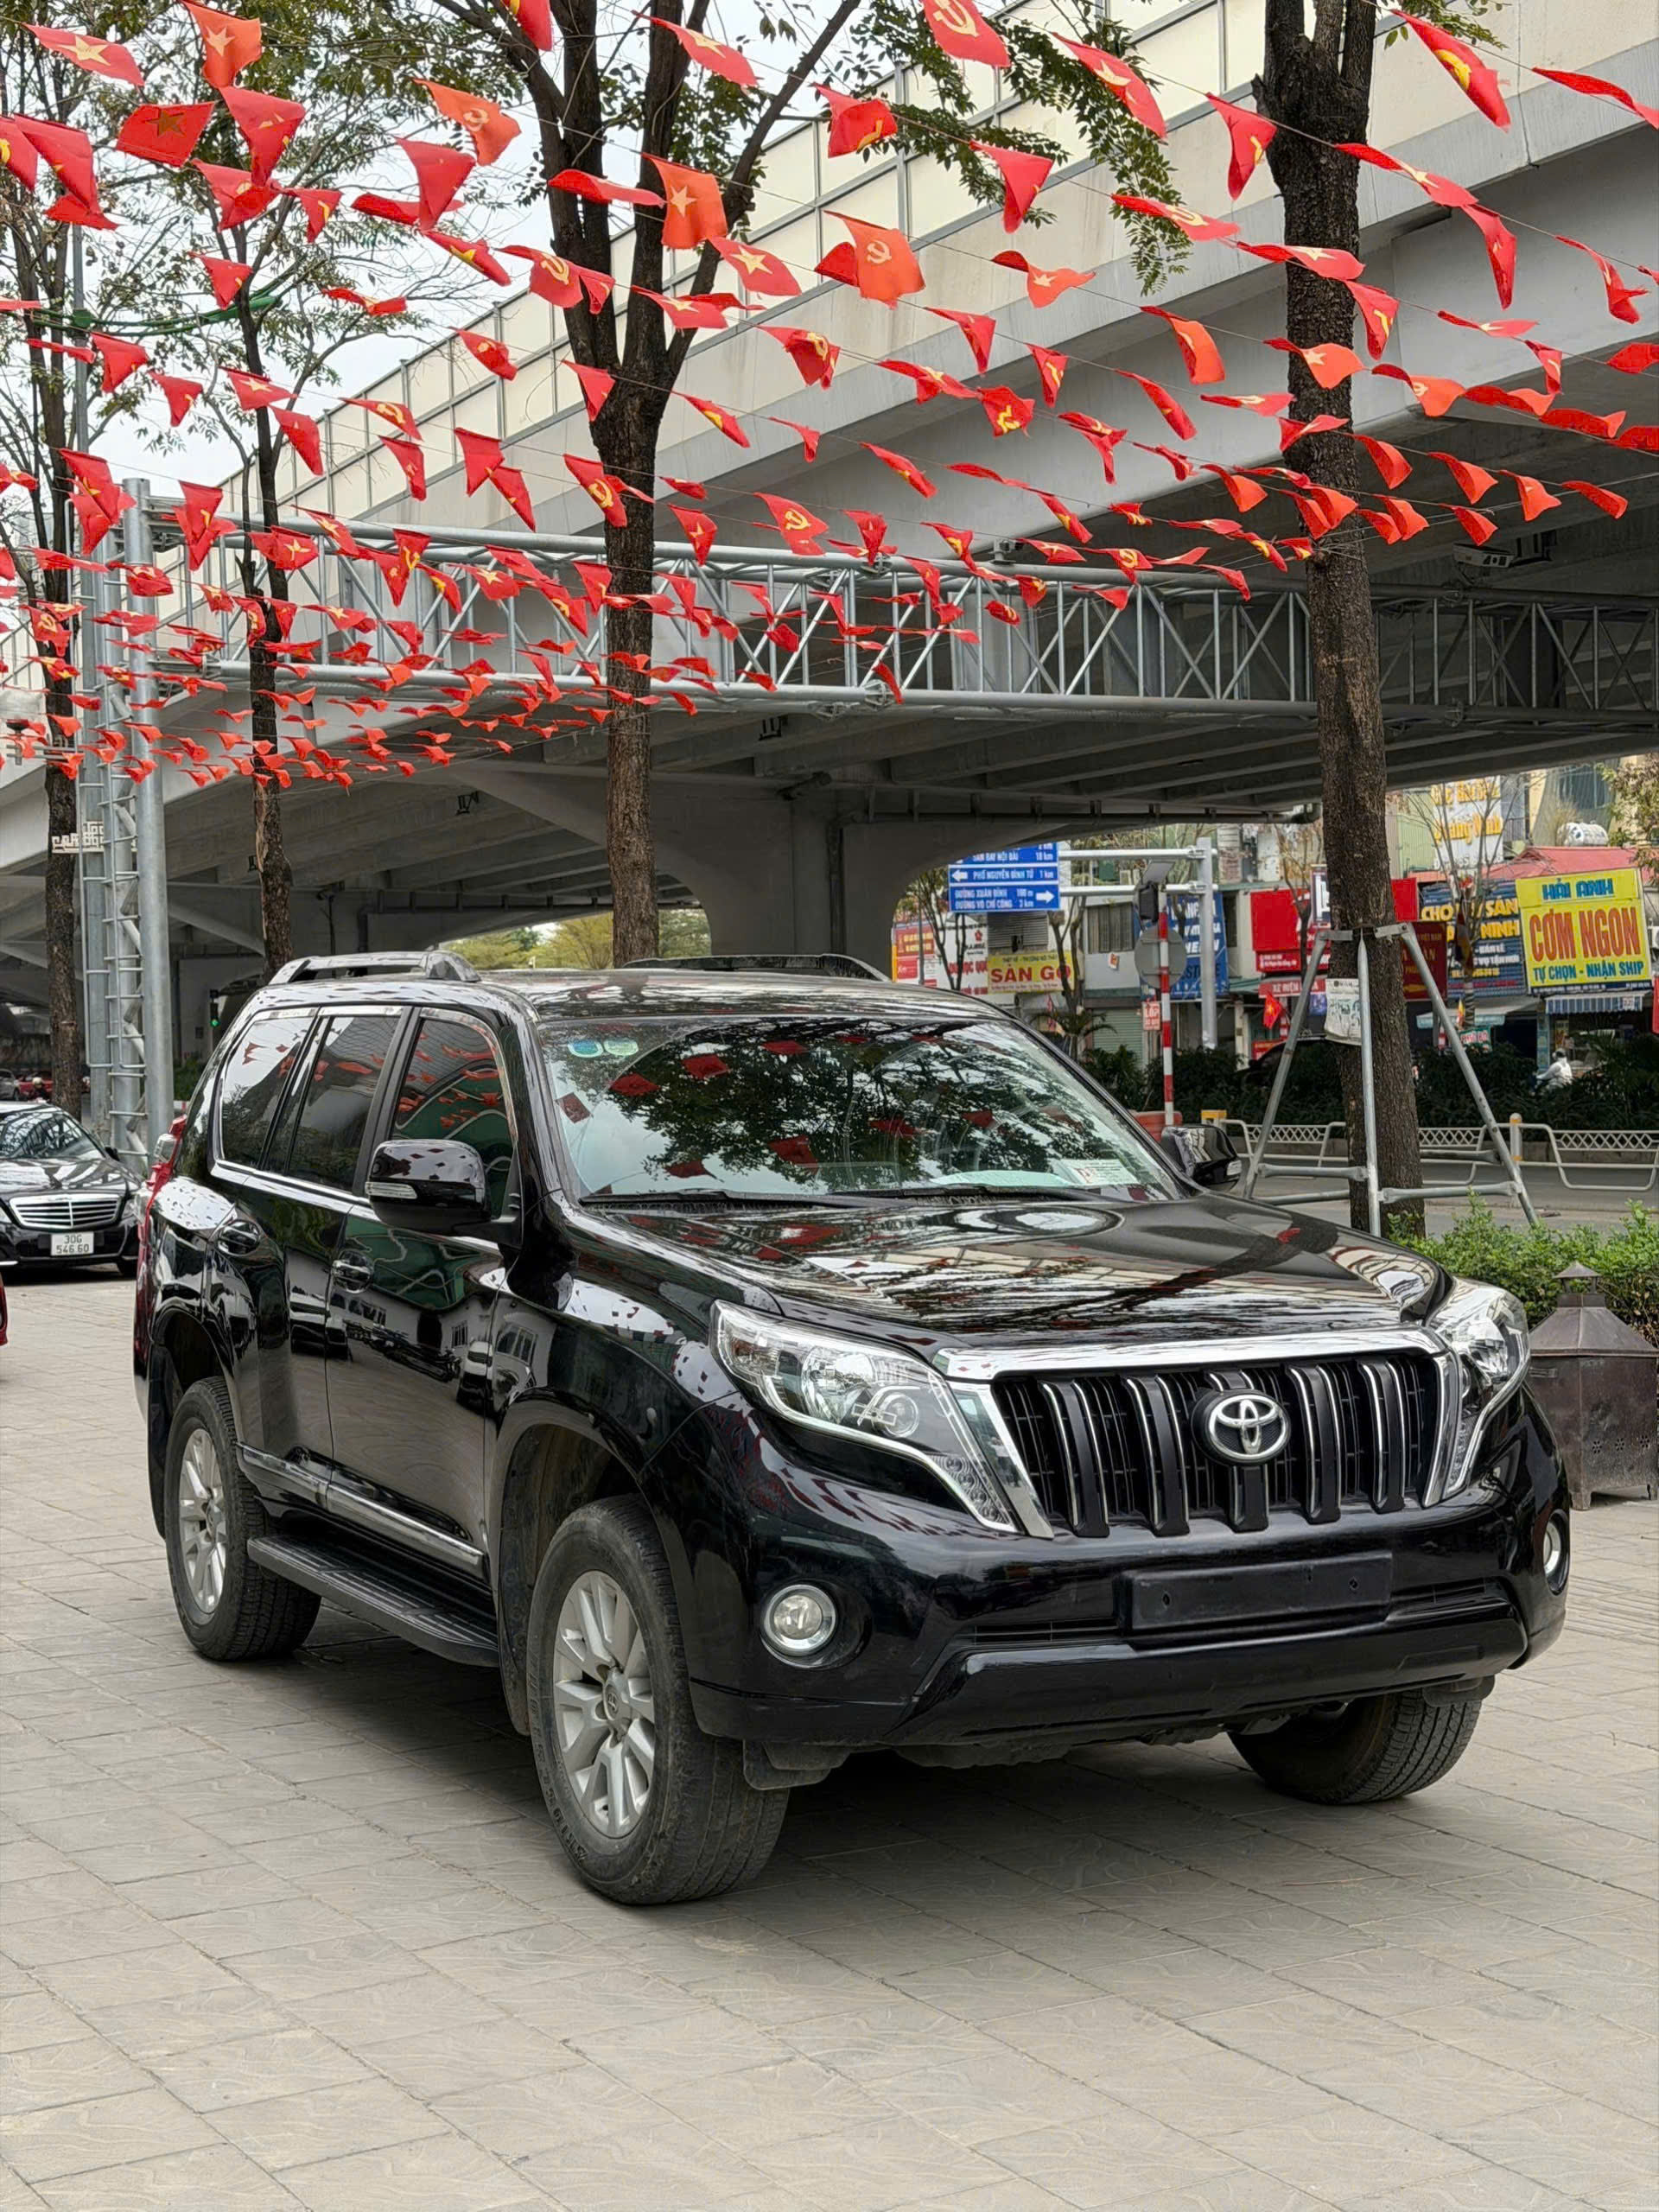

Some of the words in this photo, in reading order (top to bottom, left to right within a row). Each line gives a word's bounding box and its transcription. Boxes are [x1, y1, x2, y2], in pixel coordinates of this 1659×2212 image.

[1542, 878, 1572, 900] HẢI
[1576, 878, 1615, 899] ANH
[1480, 919, 1521, 939] NINH
[1529, 908, 1577, 962] CƠM
[1579, 907, 1641, 958] NGON
[1533, 965, 1546, 983] TỰ
[1548, 964, 1577, 982] CHỌN
[1586, 960, 1617, 980] NHẬN
[1618, 961, 1644, 976] SHIP
[64, 1234, 82, 1244] 30G
